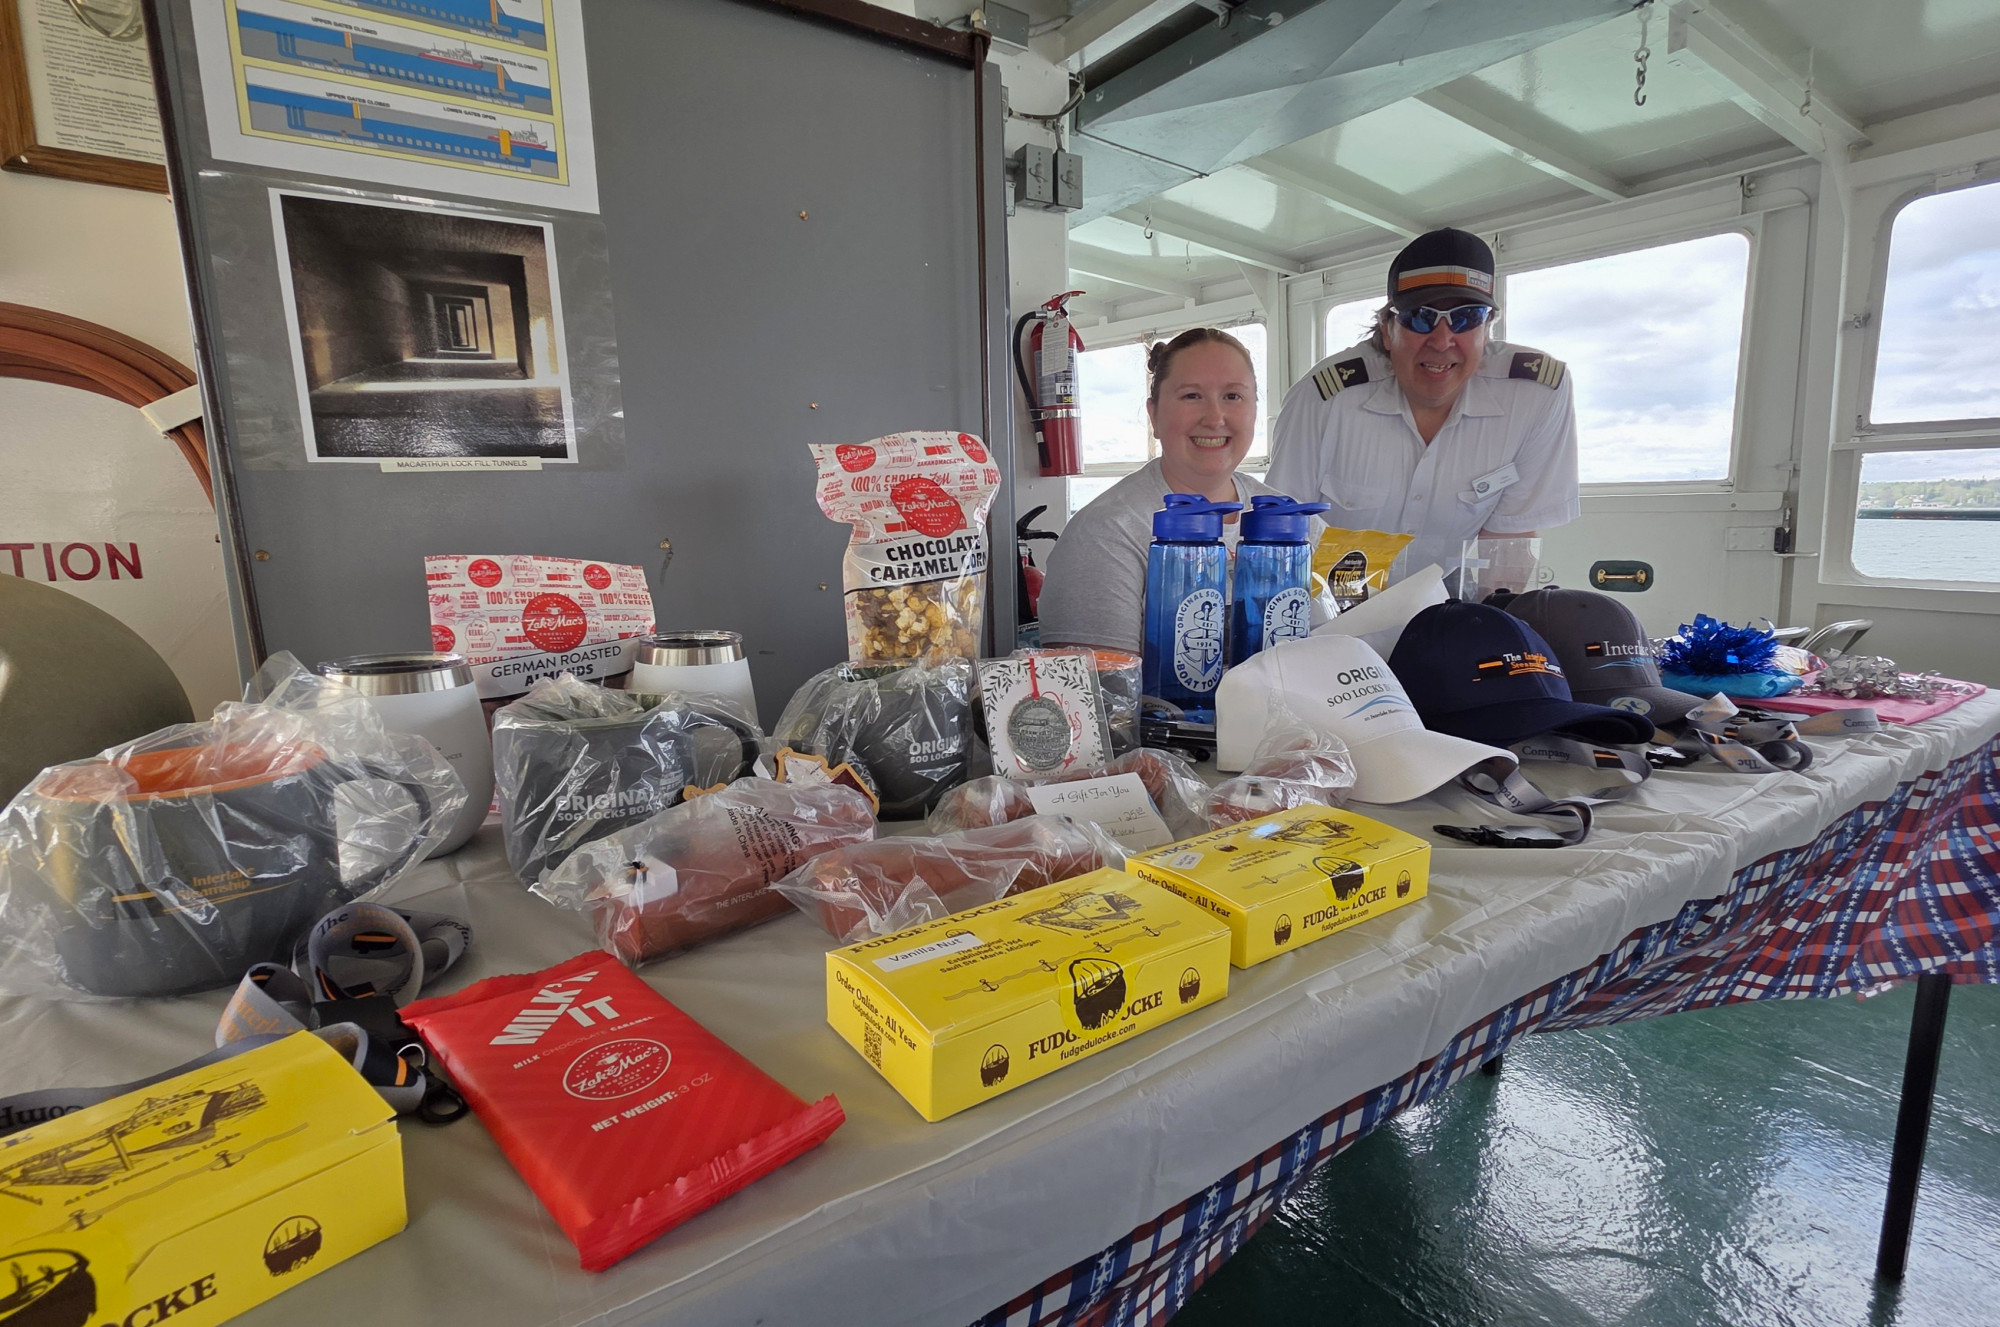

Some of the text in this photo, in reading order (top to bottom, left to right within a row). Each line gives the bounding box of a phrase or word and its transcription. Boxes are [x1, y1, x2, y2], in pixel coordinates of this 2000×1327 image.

[397, 460, 450, 468] MACARTHUR
[851, 475, 882, 492] 100%
[896, 499, 956, 513] Zak&Mac's
[886, 535, 981, 561] CHOCOLATE
[870, 557, 958, 582] CARAMEL
[486, 591, 513, 605] 100%
[600, 592, 622, 605] 100%
[1177, 591, 1219, 629] ORIGINAL SOO
[1265, 589, 1307, 626] ORIGINAL SOO
[524, 615, 584, 631] Zak&Mac's
[491, 645, 622, 678] GERMAN ROASTED
[1503, 653, 1522, 662] The
[1176, 661, 1200, 689] BOAT
[1327, 692, 1352, 708] SOO
[1352, 684, 1384, 699] LOCKS
[910, 755, 929, 763] SOO
[1521, 745, 1570, 760] Company
[1738, 759, 1762, 770] The
[1052, 785, 1130, 803] A Gift For You
[587, 808, 626, 820] LOCKS
[738, 834, 751, 858] China
[1146, 842, 1196, 861] FUDGE
[715, 889, 767, 910] THE INTERLAKE
[1137, 869, 1159, 885] Order
[1161, 880, 1187, 899] Online
[1195, 895, 1208, 908] All
[1210, 900, 1231, 918] Year
[317, 913, 349, 937] The
[848, 899, 1018, 954] FUDGE du LOCKE
[1302, 905, 1339, 930] FUDGE
[1322, 909, 1369, 932] fudgedulocke.com
[889, 938, 963, 962] Vanilla Nut
[939, 962, 962, 973] Sault
[980, 950, 1007, 961] Marie,
[1006, 939, 1042, 952] Michigan
[946, 947, 993, 965] Established
[1003, 938, 1023, 948] 1964
[972, 938, 1004, 951] Original
[566, 995, 621, 1028] IT
[836, 970, 855, 994] Order
[856, 988, 879, 1016] Online
[885, 1015, 897, 1033] All
[898, 1025, 917, 1051] Year
[852, 1000, 896, 1046] fudgedulocke.com
[513, 1016, 655, 1069] MILK CHOCOLATE CARAMEL
[1028, 1029, 1080, 1060] FUDG
[1060, 1022, 1136, 1060] fudgedulocke.com
[571, 1046, 660, 1093] Zak&Mac's
[591, 1072, 714, 1132] NET WEIGHT: 3 OZ
